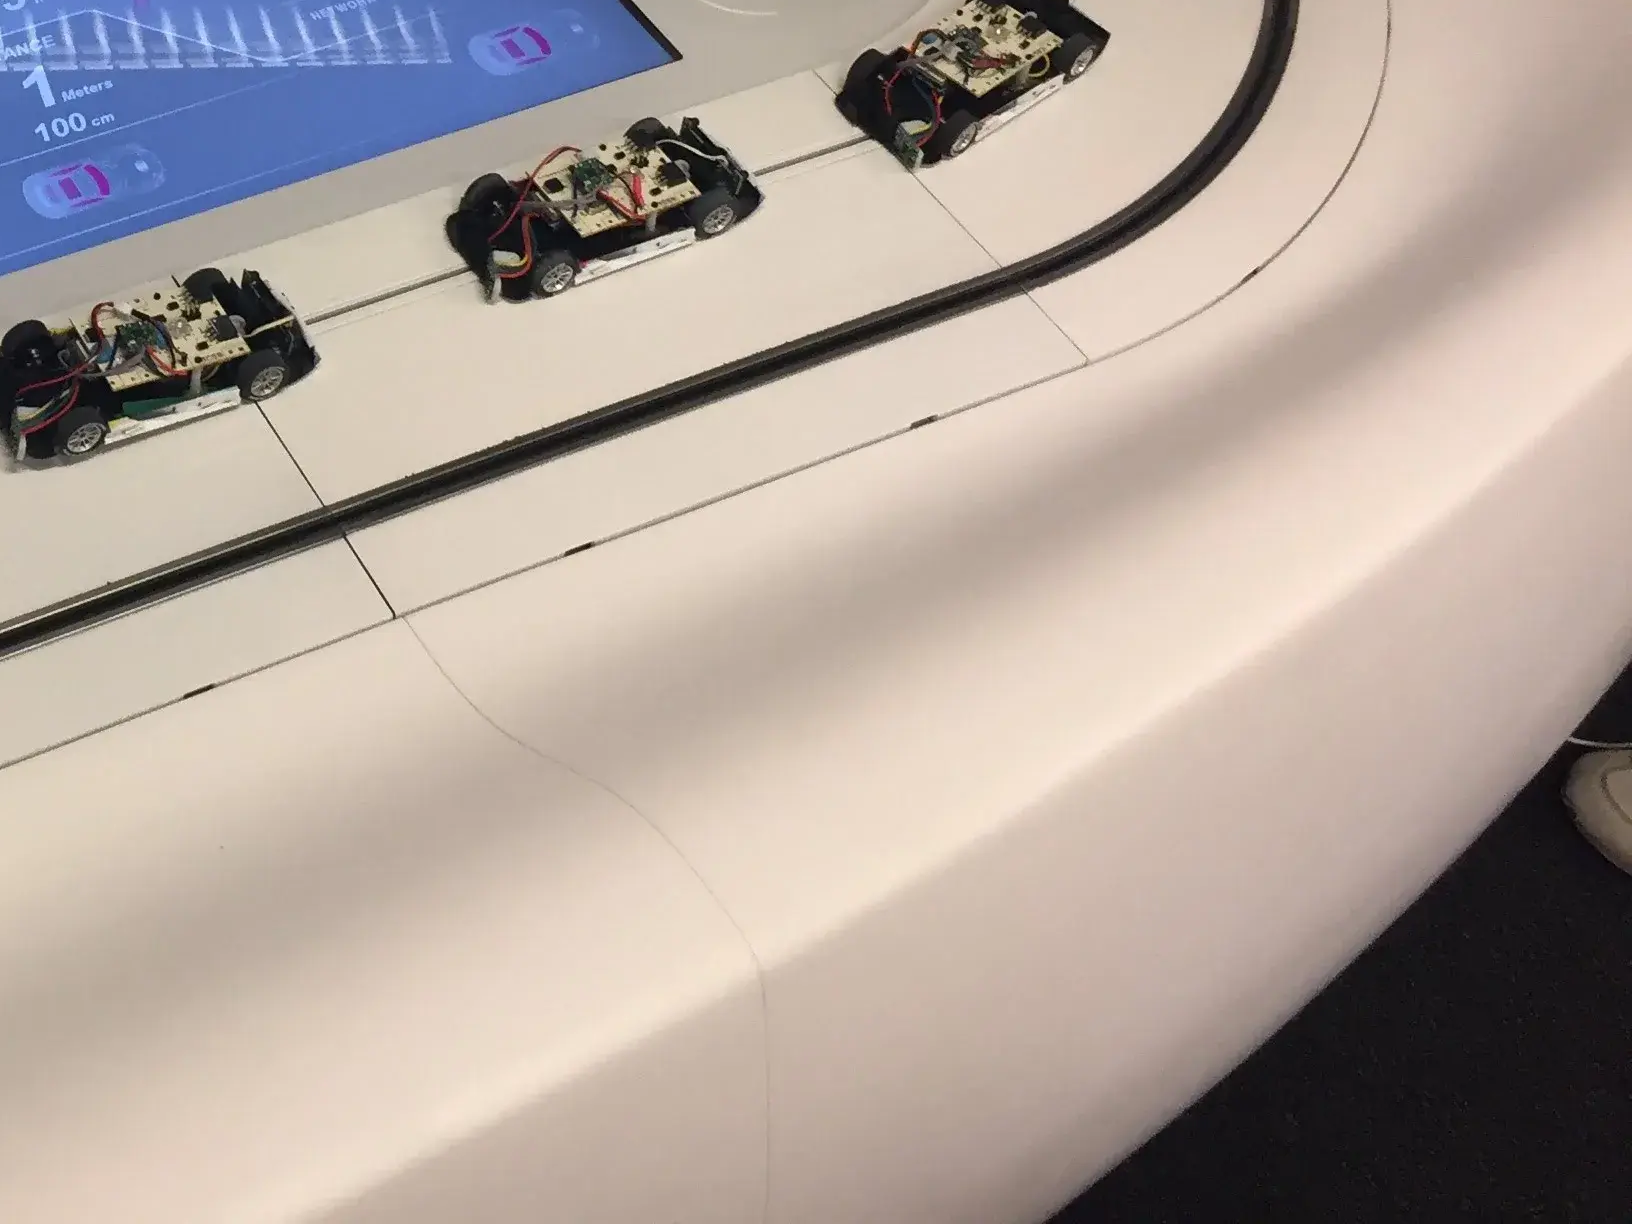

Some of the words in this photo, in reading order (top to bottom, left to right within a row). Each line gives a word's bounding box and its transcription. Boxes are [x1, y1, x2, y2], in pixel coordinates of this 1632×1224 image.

[22, 64, 57, 108] 1
[61, 79, 114, 102] Meters
[34, 112, 87, 142] 100
[91, 112, 116, 127] cm
